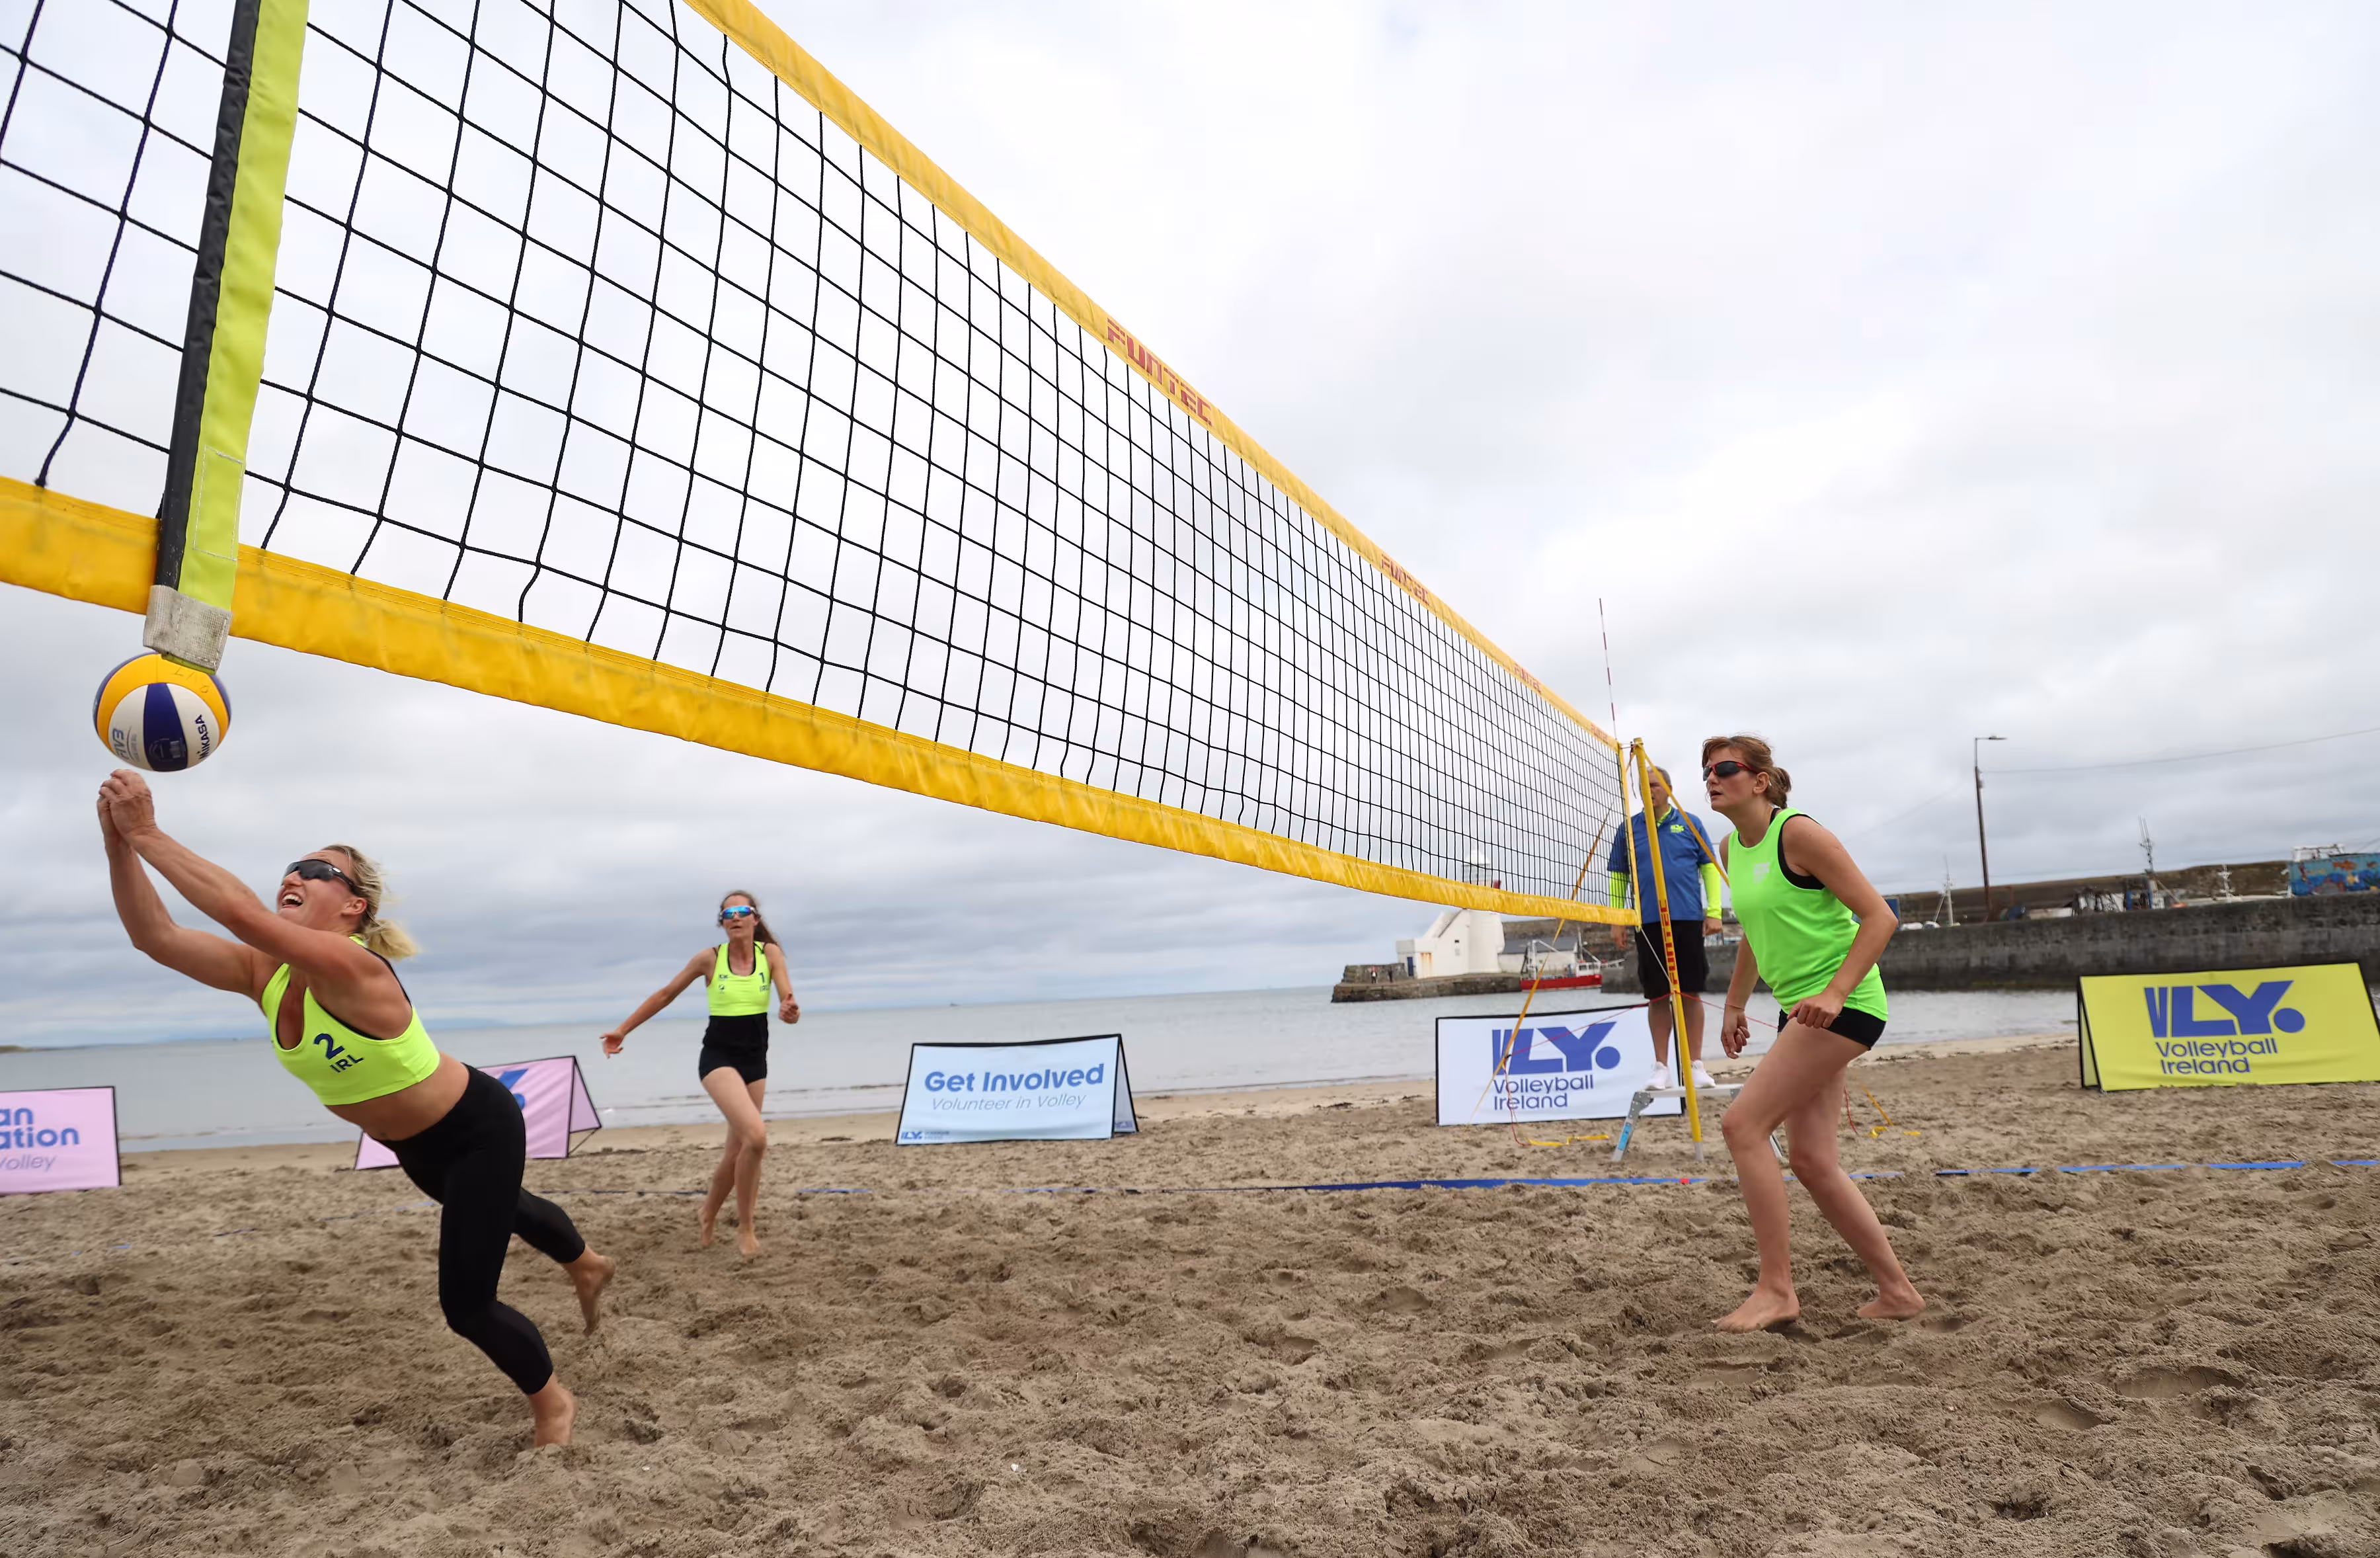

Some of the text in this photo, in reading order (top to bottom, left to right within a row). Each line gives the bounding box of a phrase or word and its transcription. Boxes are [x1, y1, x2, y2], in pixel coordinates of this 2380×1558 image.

[759, 972, 765, 983] 1
[314, 1033, 345, 1060] 2
[2155, 1038, 2278, 1057] Volleyball
[329, 1054, 364, 1073] IRL
[2161, 1056, 2251, 1075] Ireland
[925, 1063, 1105, 1092] Get Involved
[1493, 1074, 1594, 1094] Volleyball
[932, 1093, 1087, 1111] Volunteer in Volley
[1494, 1093, 1568, 1111] Ireland
